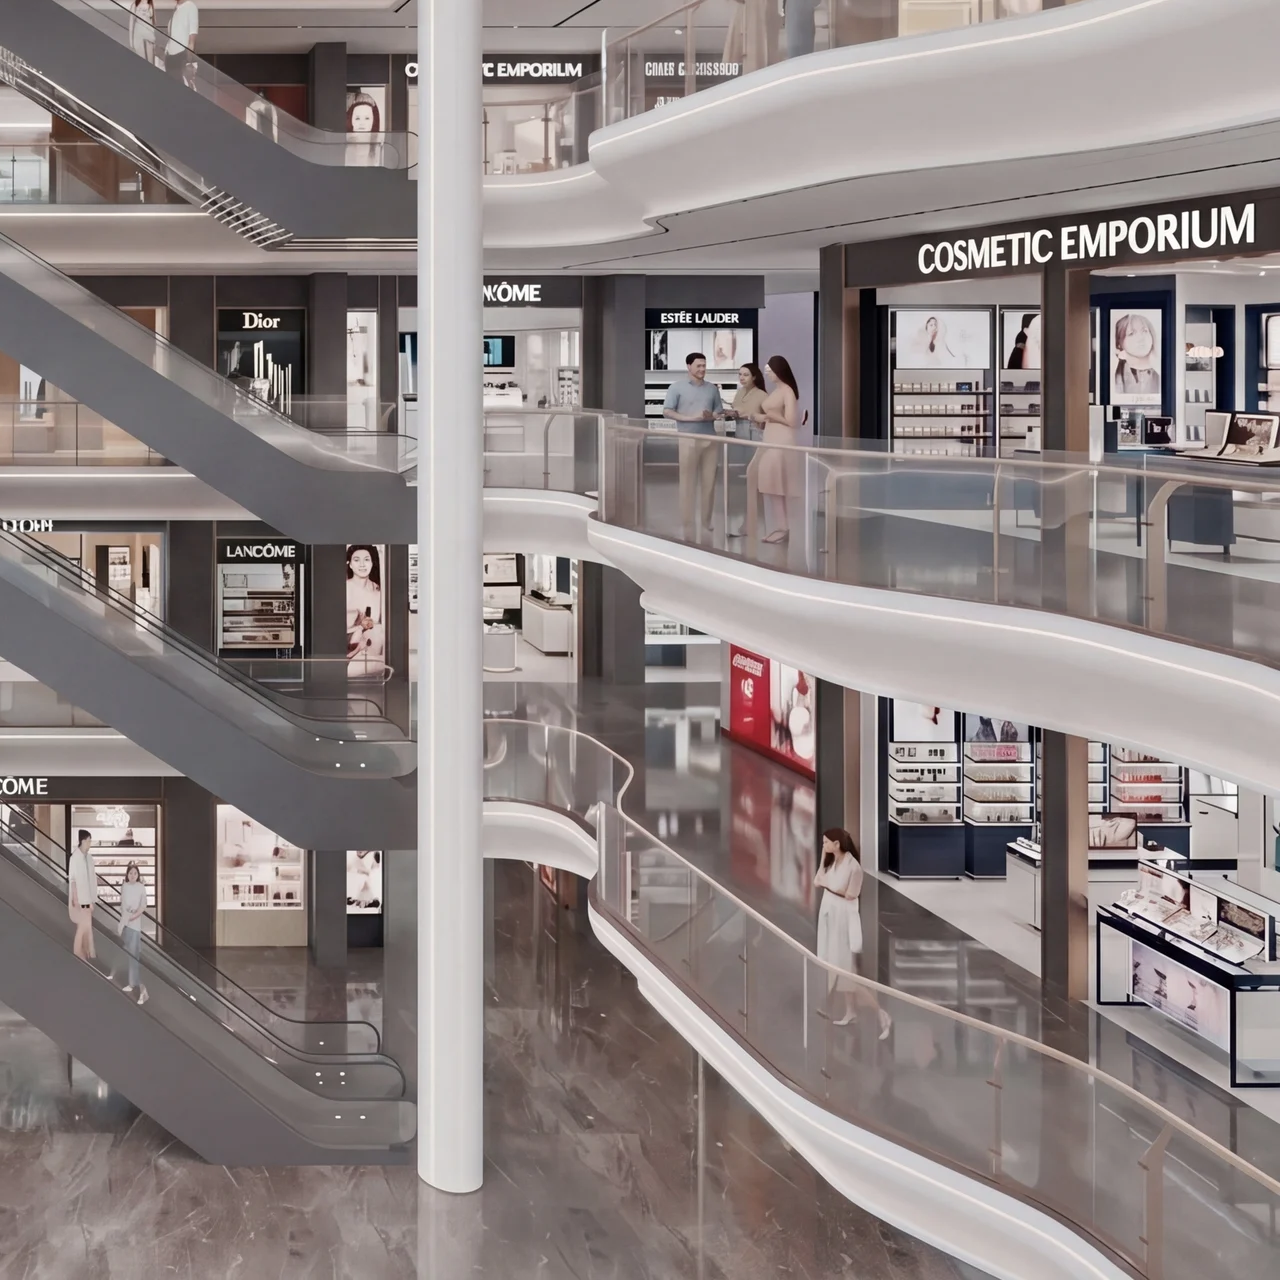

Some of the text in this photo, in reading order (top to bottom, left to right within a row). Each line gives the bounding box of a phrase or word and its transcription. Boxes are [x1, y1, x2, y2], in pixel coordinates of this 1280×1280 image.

[918, 203, 1256, 274] COSMETIC EMPORIUM
[242, 312, 280, 329] Dior
[660, 311, 739, 323] ESTÉE LAUDER
